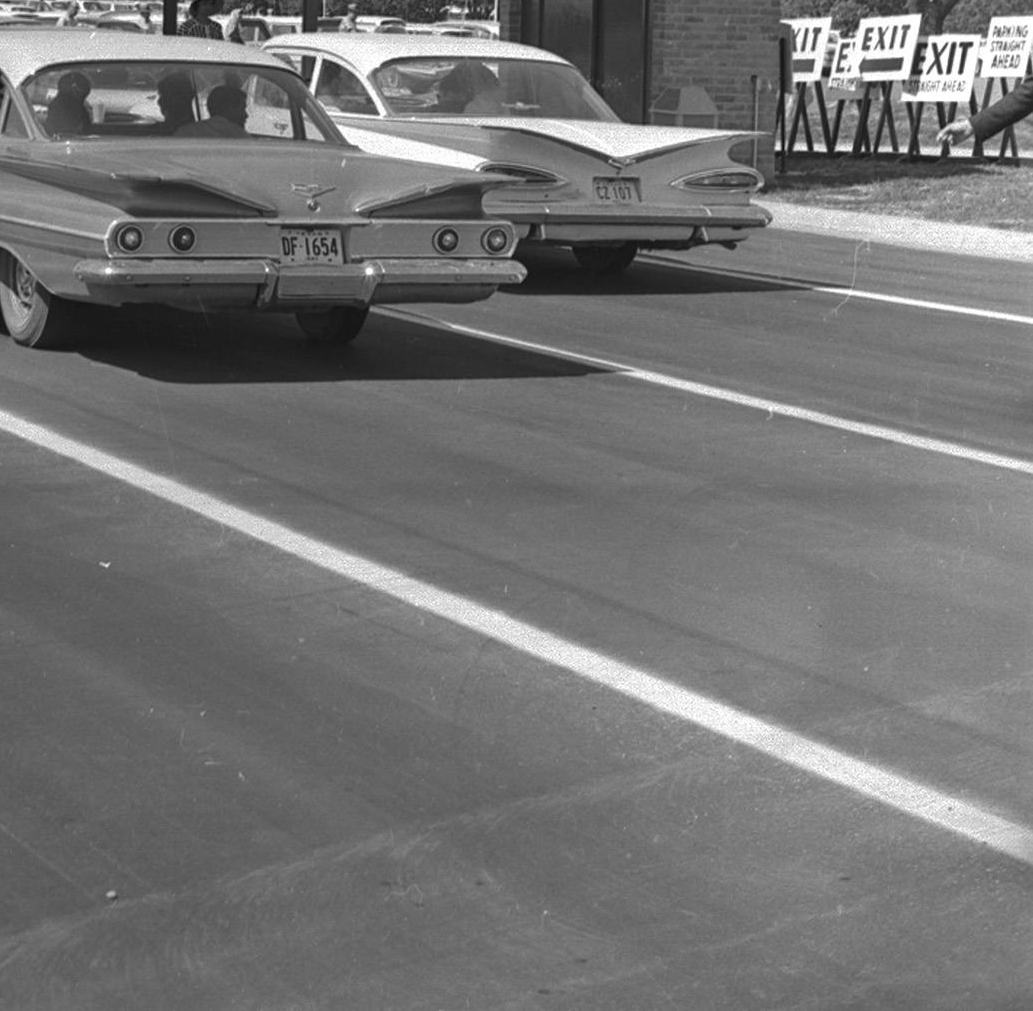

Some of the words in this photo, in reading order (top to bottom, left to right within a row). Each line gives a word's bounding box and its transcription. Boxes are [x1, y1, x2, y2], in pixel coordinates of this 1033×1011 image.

[861, 24, 911, 51] EXIT
[992, 25, 1029, 38] PARKING
[792, 27, 822, 52] XIT
[990, 41, 1027, 52] STRAIGHT
[910, 41, 974, 75] EXIT
[991, 55, 1021, 69] AHEAD
[613, 185, 632, 199] 107
